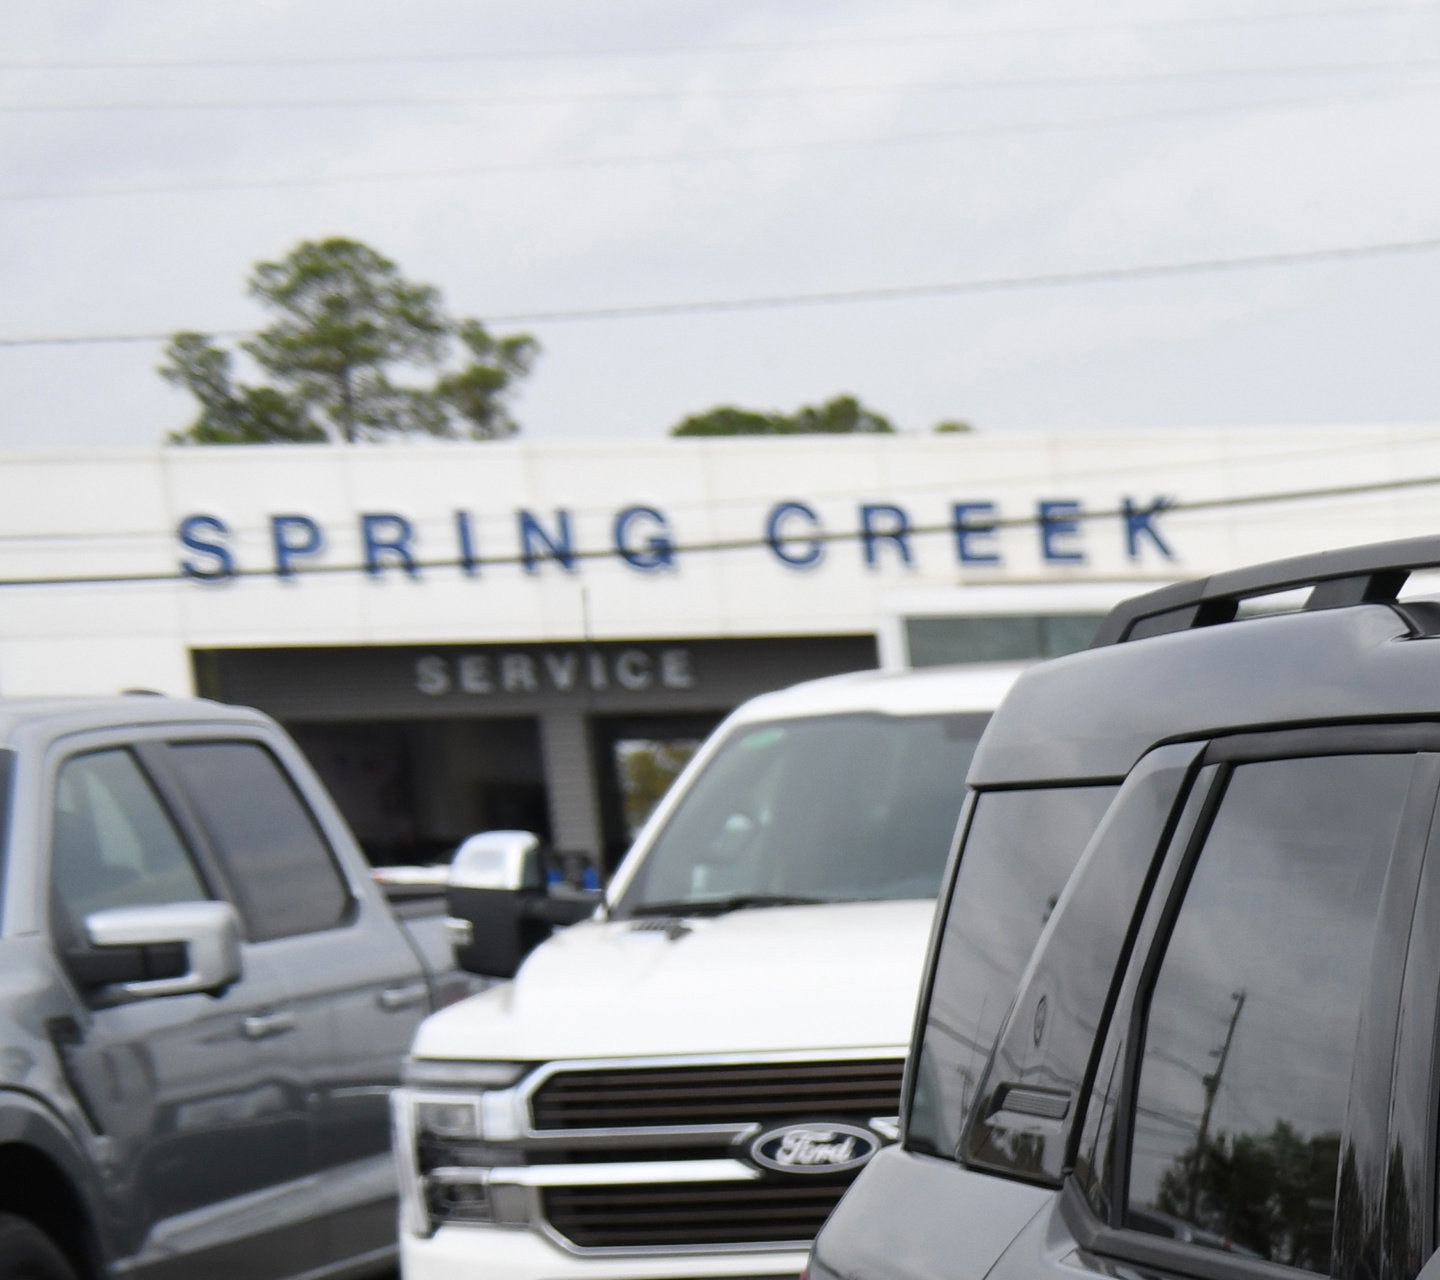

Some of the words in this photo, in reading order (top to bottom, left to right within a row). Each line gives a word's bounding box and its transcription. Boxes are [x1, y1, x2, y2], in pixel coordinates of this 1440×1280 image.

[177, 504, 676, 583] SPRING
[765, 494, 1179, 570] CREEK
[415, 649, 695, 696] SERVICE
[775, 1129, 857, 1166] Ford
